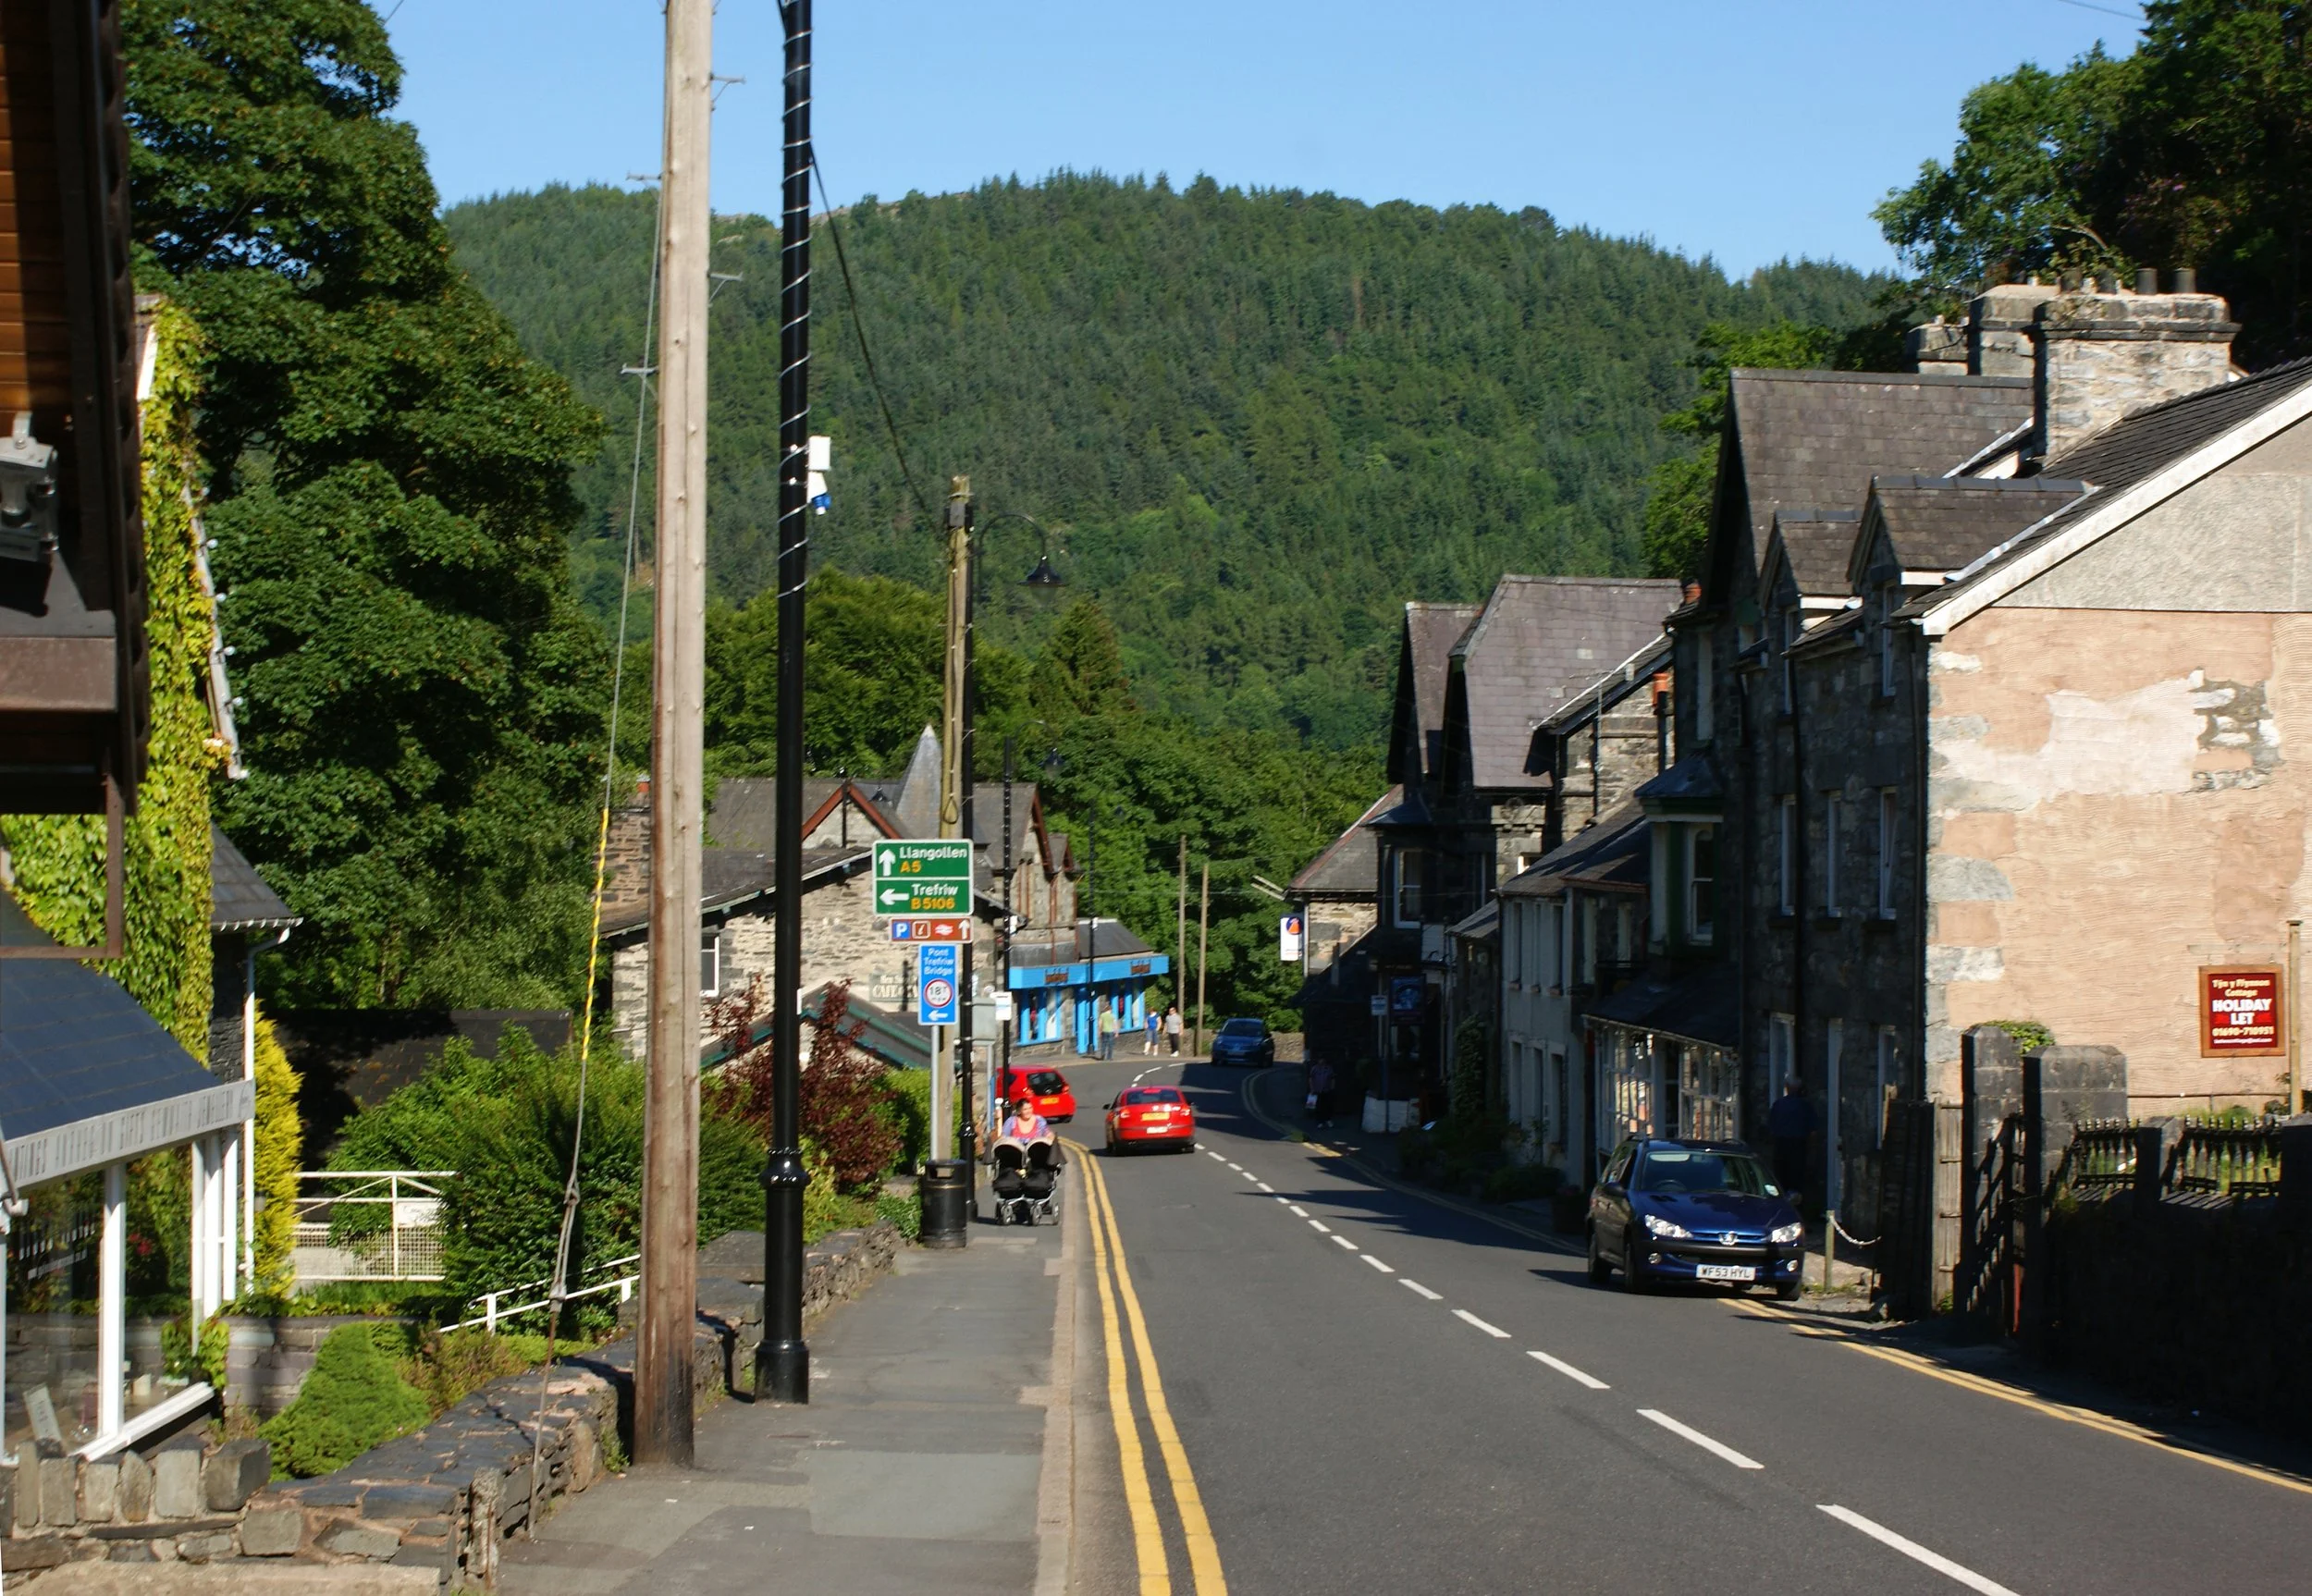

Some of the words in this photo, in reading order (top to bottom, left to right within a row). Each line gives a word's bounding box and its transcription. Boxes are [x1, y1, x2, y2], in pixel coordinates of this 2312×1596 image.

[900, 846, 967, 861] Llangollen
[900, 860, 922, 873] A5
[911, 883, 958, 896] Trefriw
[911, 897, 955, 910] B5106
[928, 948, 949, 956] Pont
[924, 966, 953, 976] Bridge
[2224, 988, 2258, 998] Cottage
[2212, 999, 2272, 1013] HOLIDAY
[2231, 1013, 2255, 1025] LET
